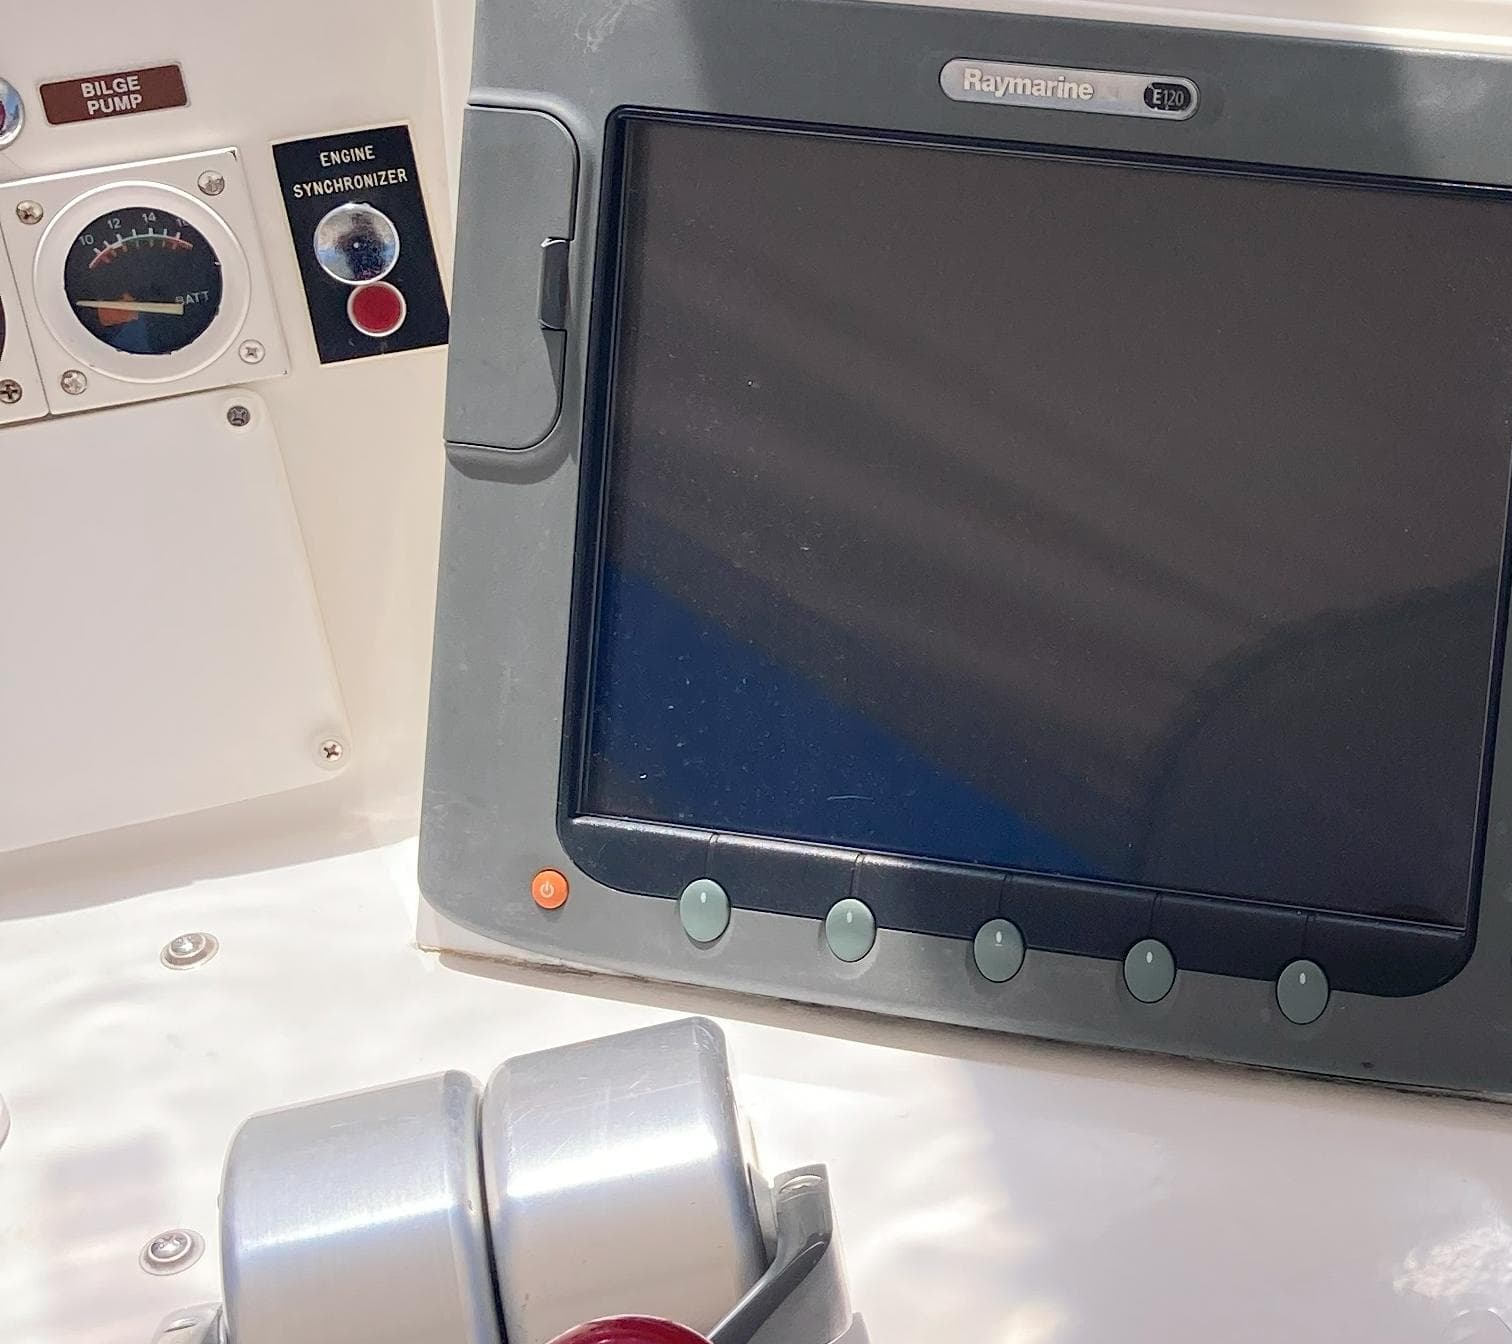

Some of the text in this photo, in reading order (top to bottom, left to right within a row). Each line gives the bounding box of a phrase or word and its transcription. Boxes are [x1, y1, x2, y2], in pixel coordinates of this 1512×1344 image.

[81, 76, 141, 98] BILGE
[962, 67, 1186, 107] Raymarine E120
[87, 94, 142, 116] PUMP
[319, 144, 376, 167] ENGINE
[292, 167, 408, 199] SYNCHRONIZER
[107, 217, 121, 230] 12
[142, 211, 157, 223] 14
[80, 234, 94, 246] 10
[175, 290, 209, 305] BATT
